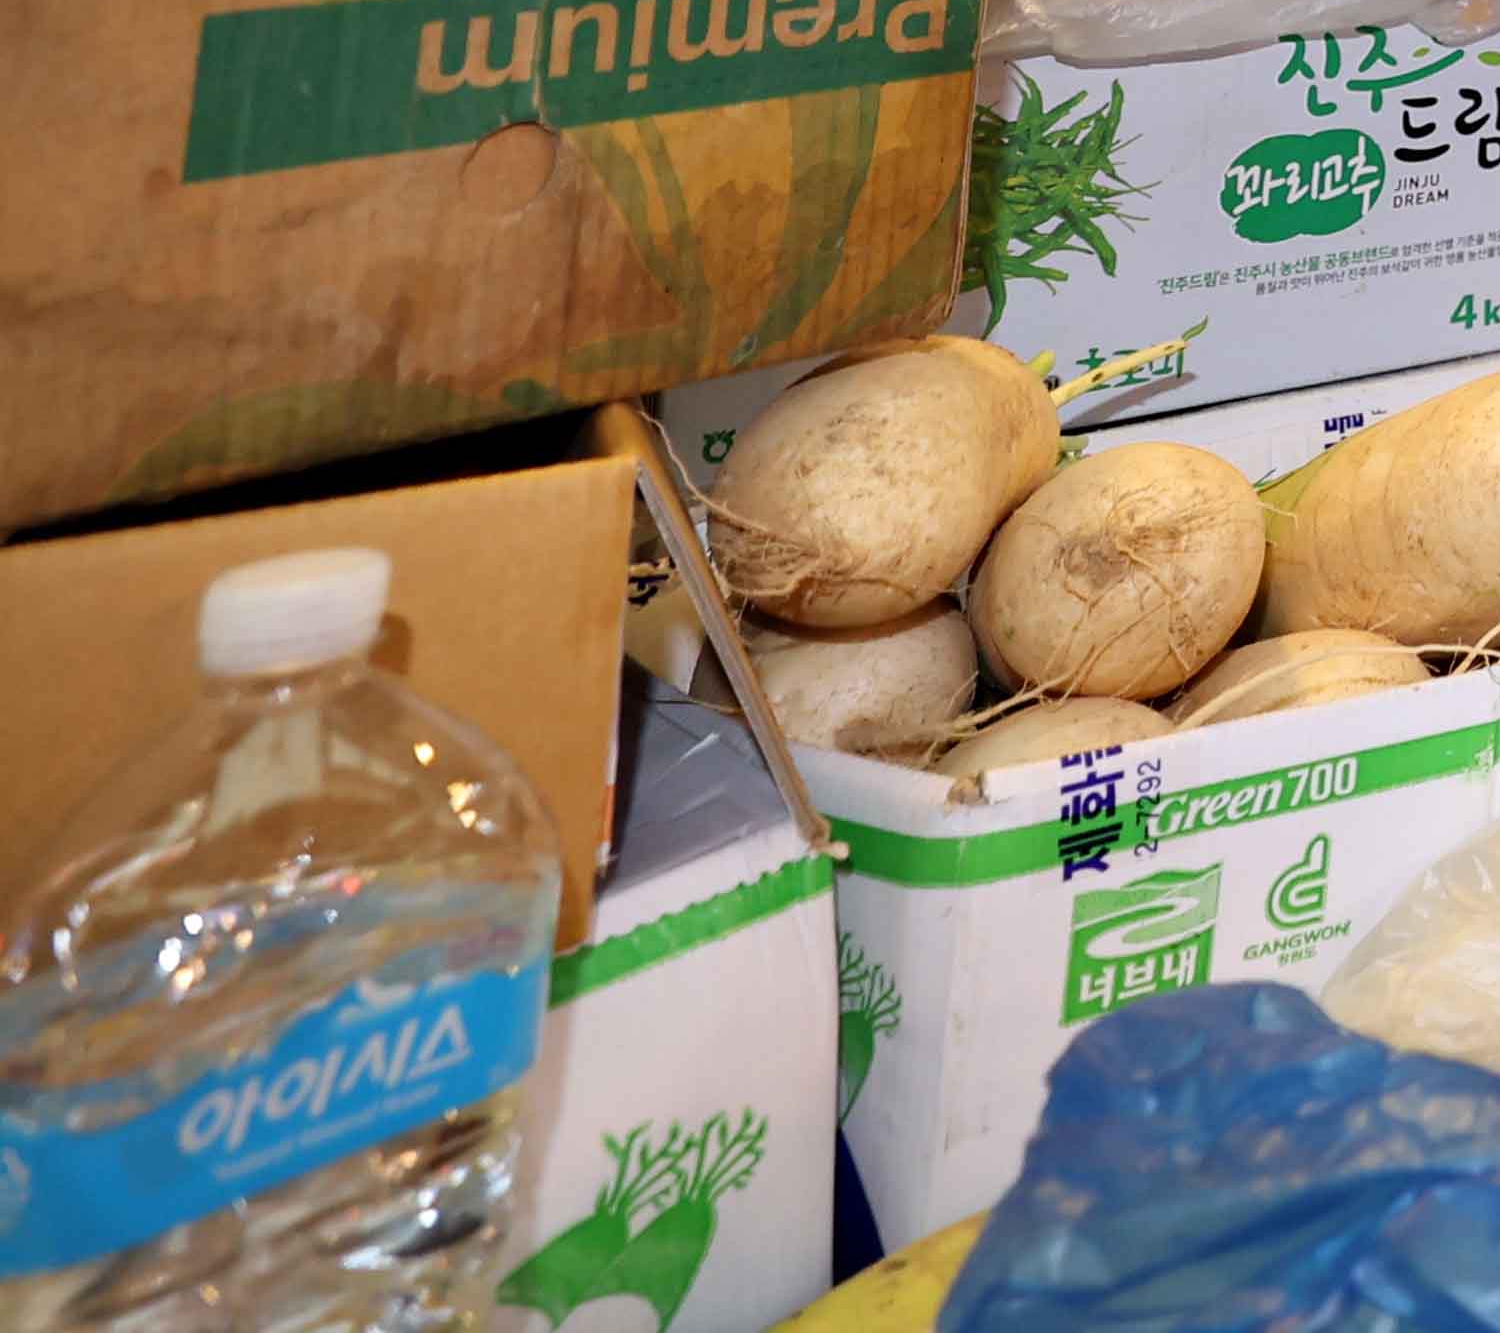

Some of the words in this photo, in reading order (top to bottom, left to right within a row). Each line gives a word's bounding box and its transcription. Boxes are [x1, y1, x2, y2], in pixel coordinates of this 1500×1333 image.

[1277, 25, 1465, 117] 진주
[1226, 135, 1381, 216] 꽈리고추
[1392, 188, 1449, 210] DREAM
[1394, 174, 1440, 191] JINJU
[1233, 262, 1277, 284] 진주시
[1279, 254, 1322, 276] 농산물
[1134, 757, 1163, 858] 2-7292
[1147, 779, 1282, 838] Green
[1288, 756, 1359, 808] 700
[1078, 943, 1199, 1009] 너브내
[1242, 920, 1352, 962] GANGWON
[177, 1004, 471, 1154] 아이시스
